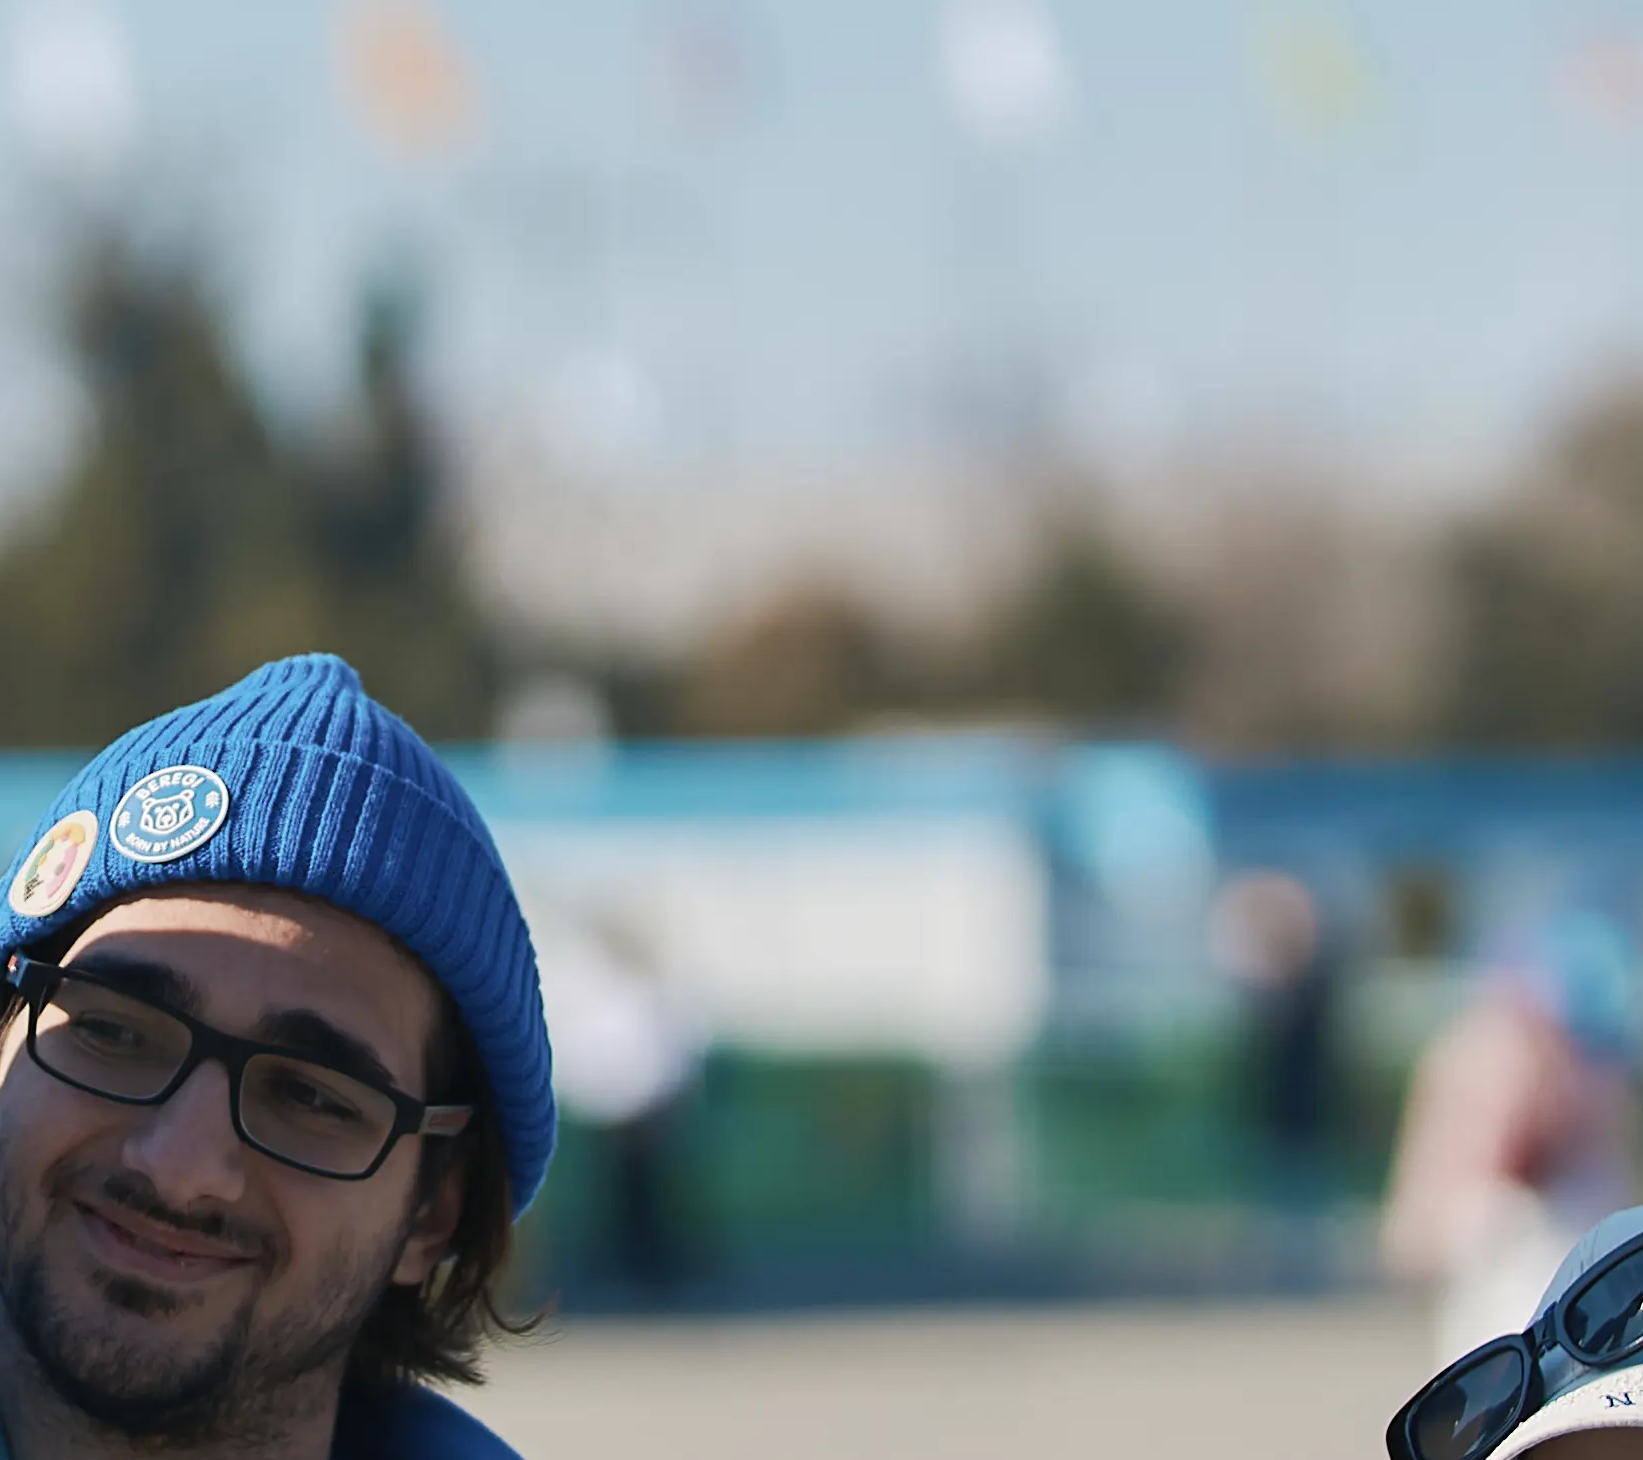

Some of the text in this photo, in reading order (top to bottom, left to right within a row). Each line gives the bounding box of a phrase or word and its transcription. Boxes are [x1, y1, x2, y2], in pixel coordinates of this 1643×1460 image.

[135, 772, 205, 801] BEREGI
[125, 817, 211, 853] BORN BY NATURE
